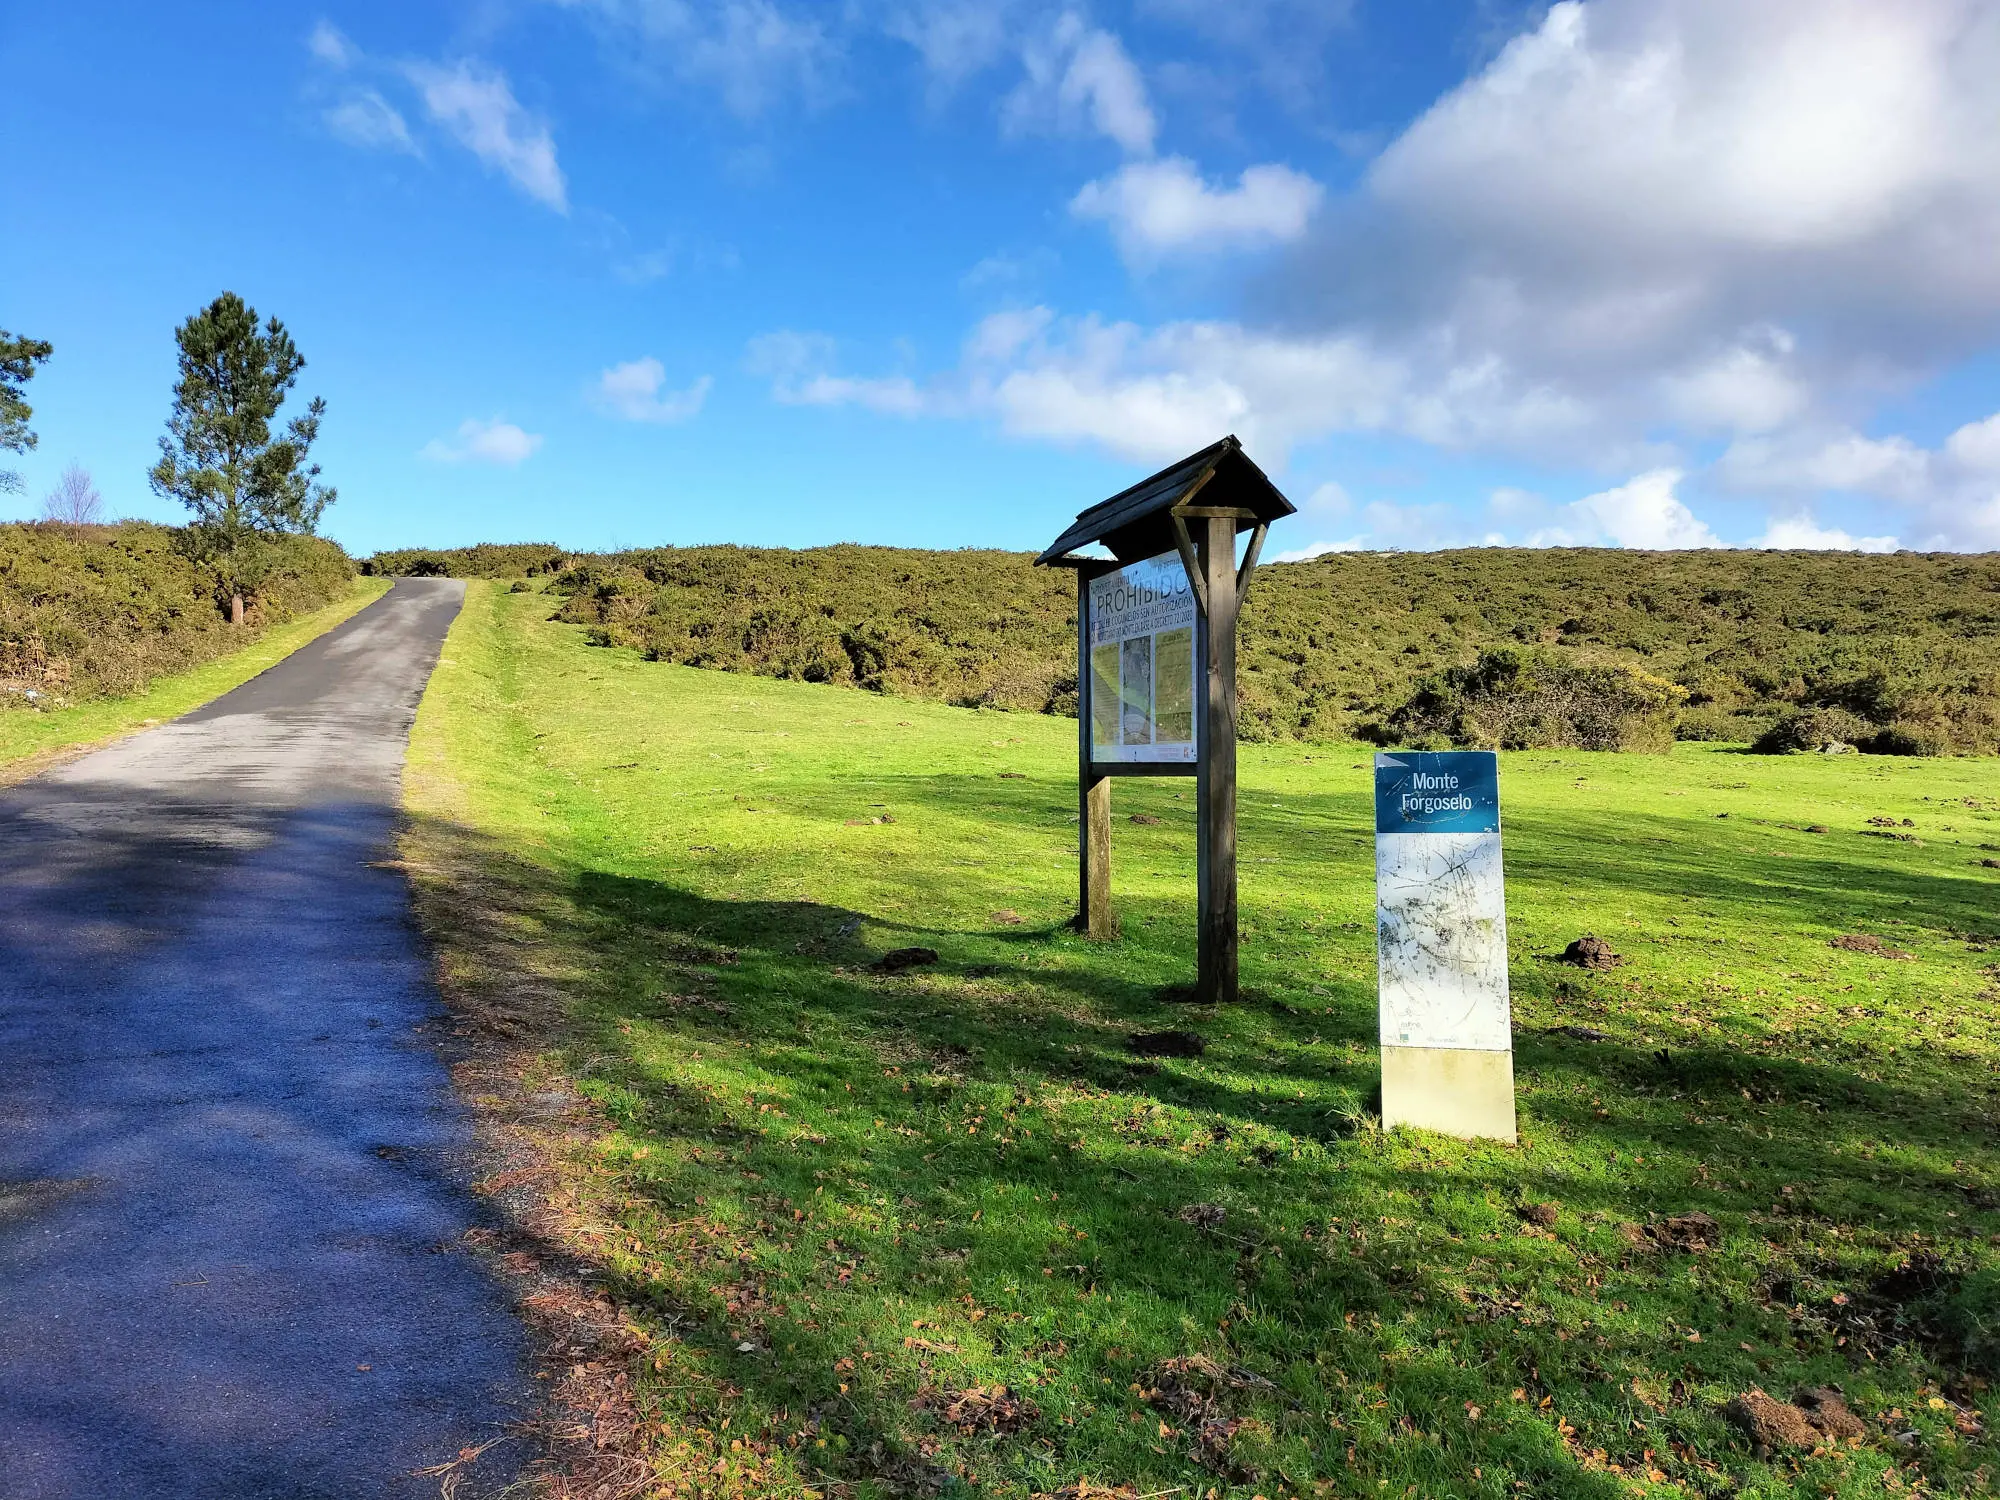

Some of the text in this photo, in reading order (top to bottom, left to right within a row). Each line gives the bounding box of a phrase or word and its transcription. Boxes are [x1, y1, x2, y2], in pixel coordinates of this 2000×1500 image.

[1097, 571, 1188, 618] PROHIBIDO
[1413, 773, 1459, 790] Monte
[1402, 793, 1472, 814] Forgoselo
